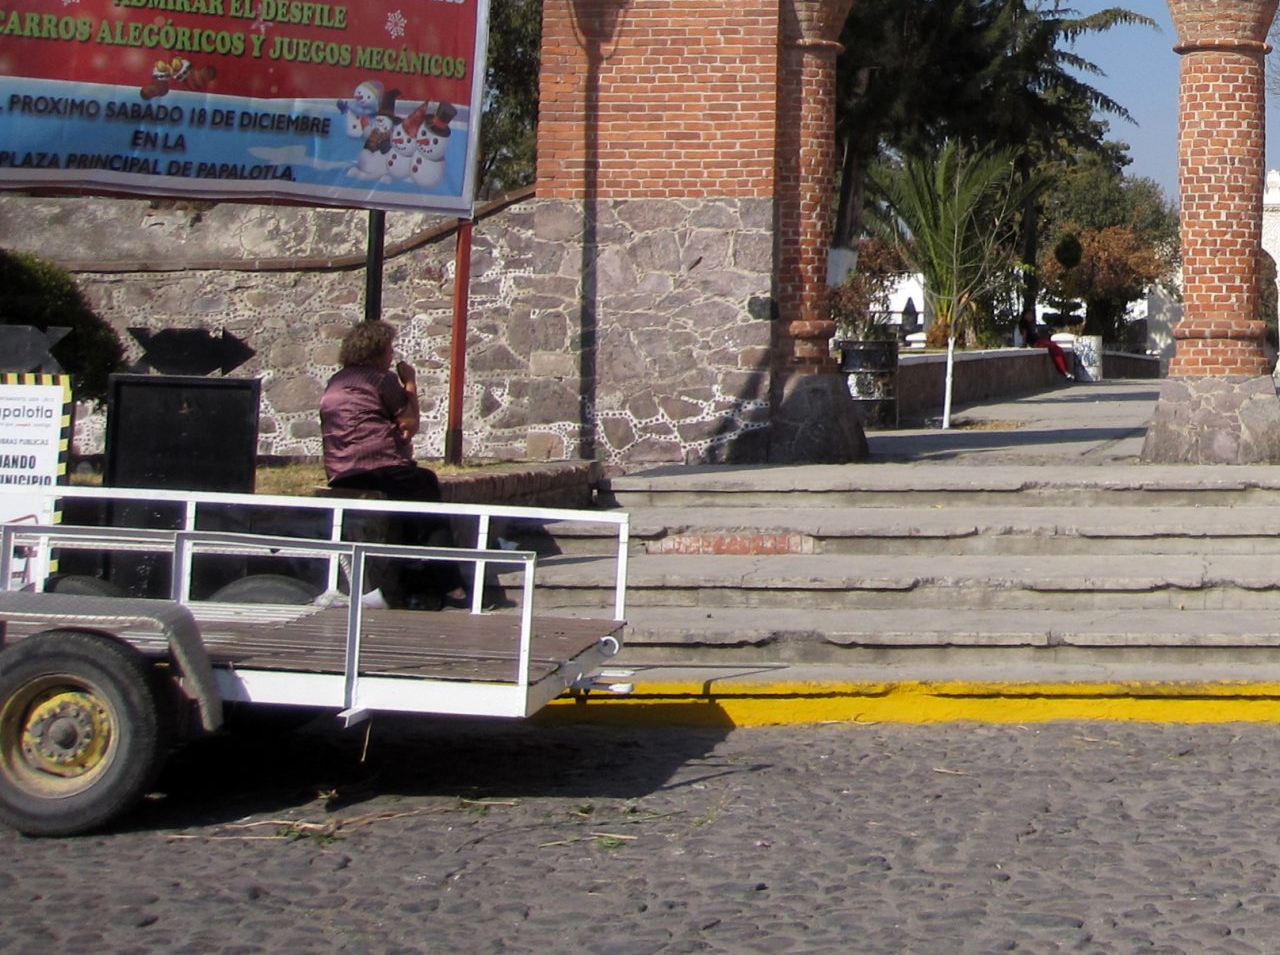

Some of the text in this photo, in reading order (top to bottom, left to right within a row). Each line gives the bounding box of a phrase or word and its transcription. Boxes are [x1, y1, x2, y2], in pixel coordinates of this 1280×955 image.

[95, 18, 246, 57] ALEGÓRICOS
[250, 33, 266, 58] Y
[269, 36, 353, 66] JUEGOS
[355, 44, 466, 80] MECÁNICOS
[8, 94, 332, 134] PROXIMO SABADO 18 DE DICIEMBRE
[131, 129, 187, 150] EN LA
[0, 151, 297, 182] PLAZA PRINCIPAL DE PAPALOTLA.
[0, 406, 54, 421] palotla
[0, 455, 37, 469] ANDO
